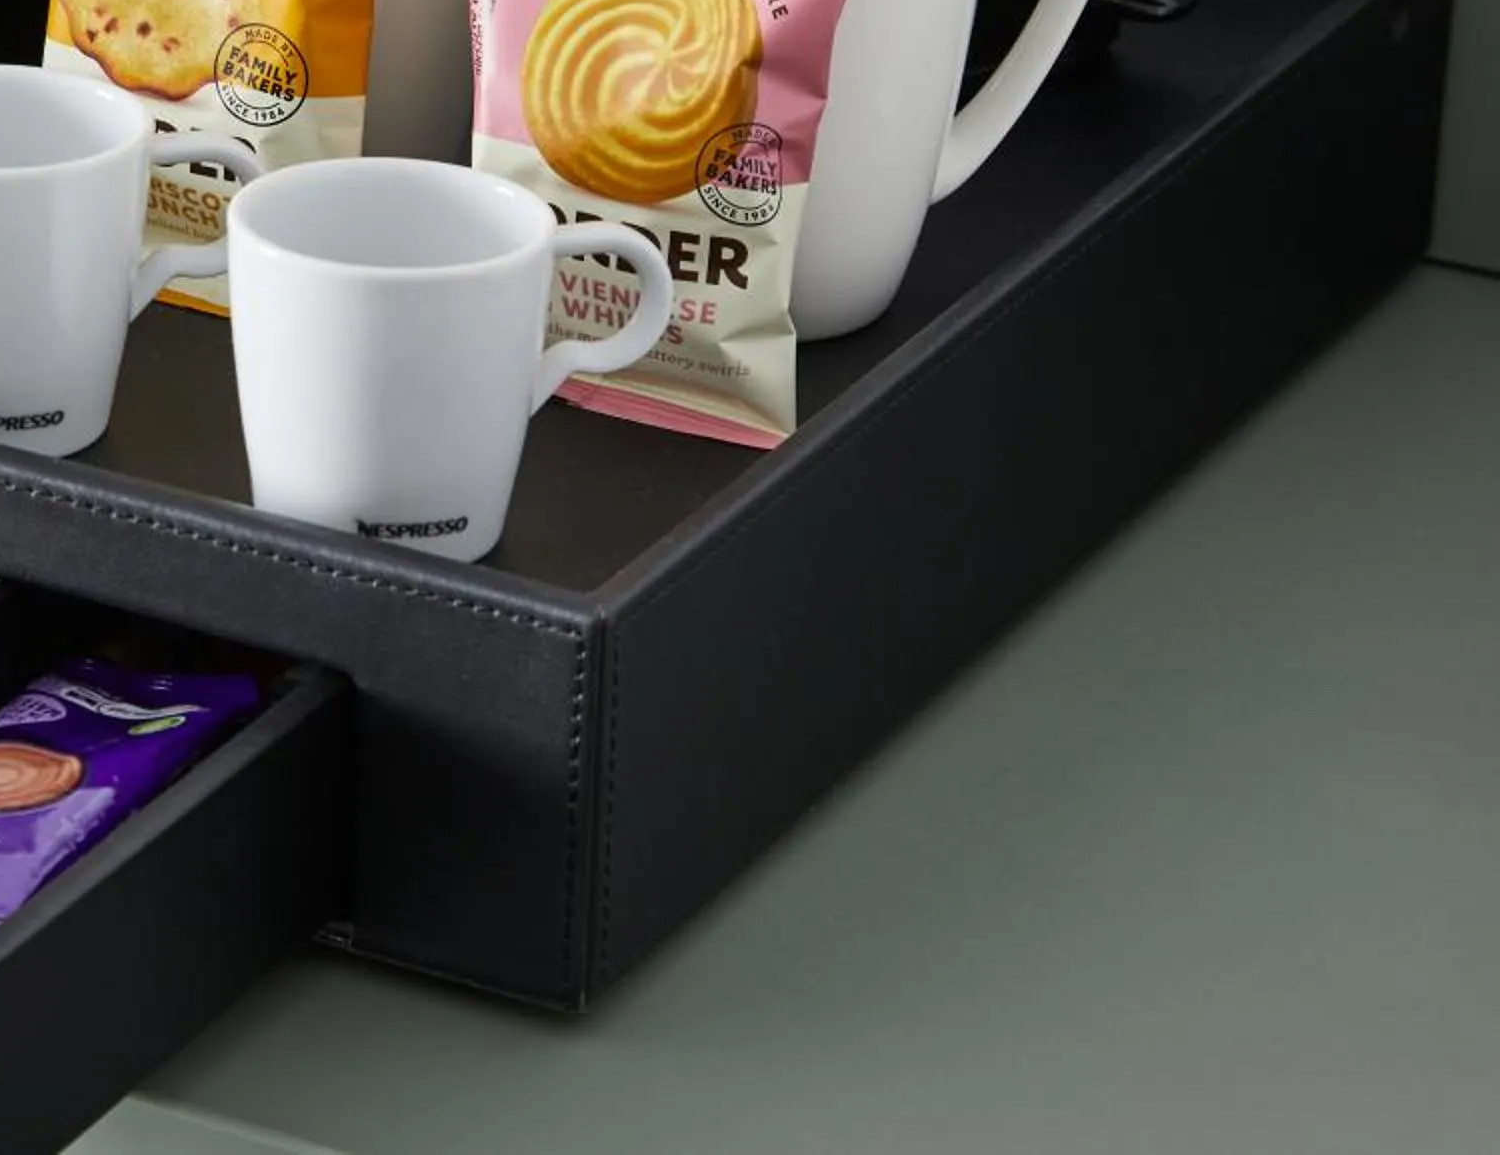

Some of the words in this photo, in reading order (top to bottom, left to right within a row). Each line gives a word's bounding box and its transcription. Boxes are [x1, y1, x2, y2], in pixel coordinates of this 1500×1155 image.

[244, 28, 279, 43] MADE
[222, 60, 296, 102] BAKERS
[229, 45, 298, 86] FAMILY
[705, 162, 778, 196] BAKERS
[712, 147, 778, 178] FAMILY
[703, 186, 739, 219] SINCE
[558, 270, 718, 326] VIENSE
[561, 295, 684, 345] WHIS
[353, 516, 469, 540] NESPRESSO
